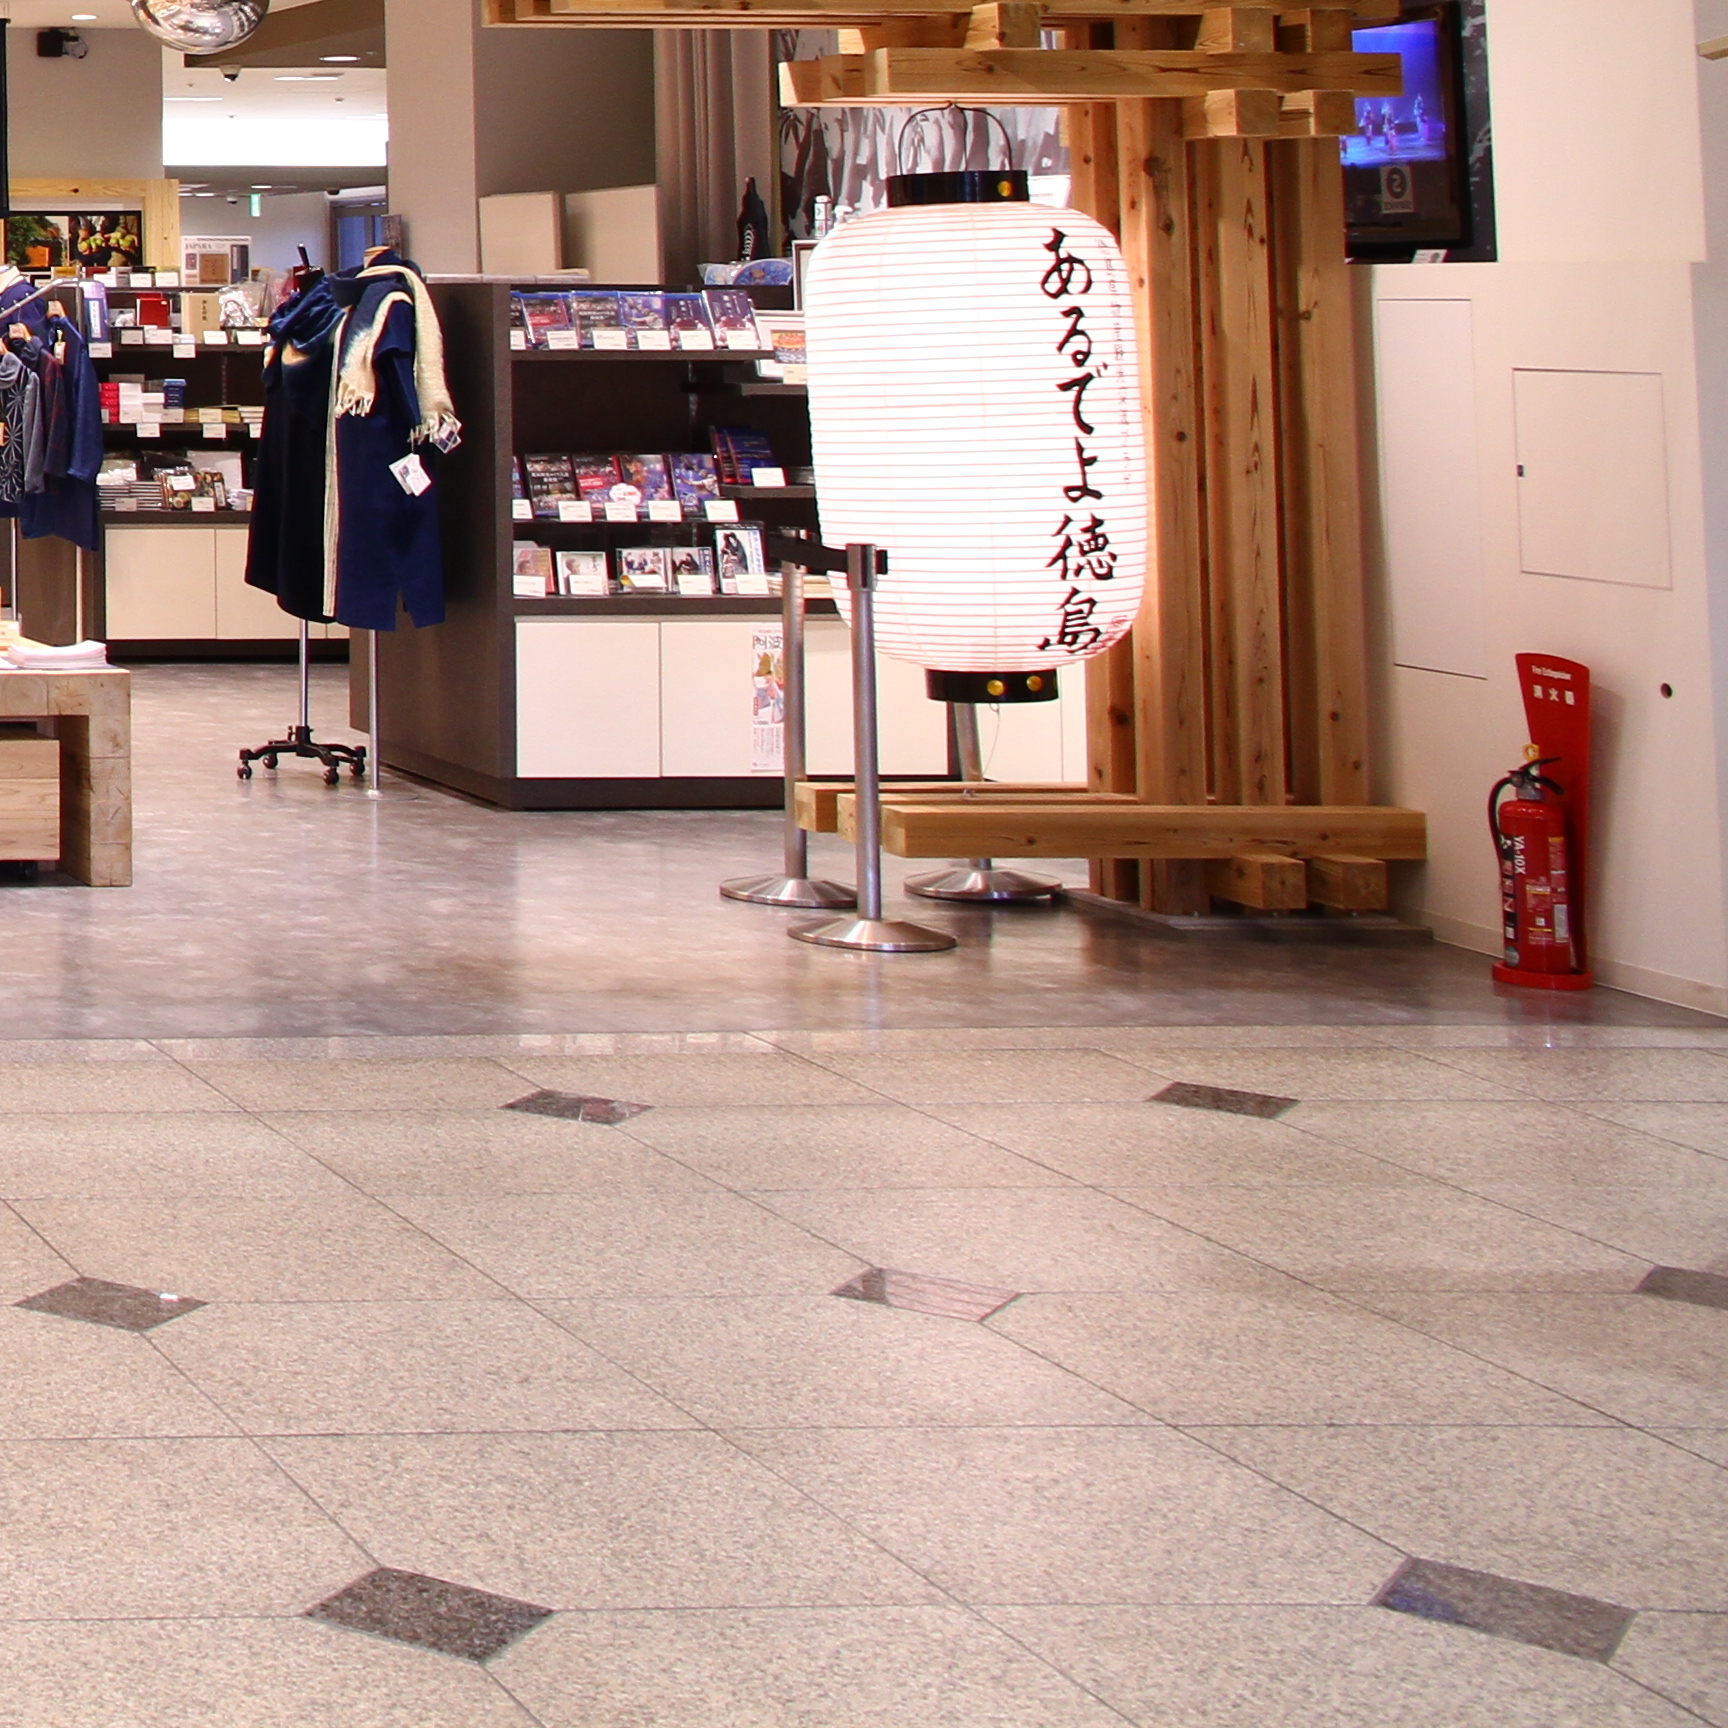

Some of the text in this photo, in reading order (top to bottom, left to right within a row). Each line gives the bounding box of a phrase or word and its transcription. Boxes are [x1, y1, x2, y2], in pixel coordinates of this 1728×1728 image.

[1038, 228, 1118, 654] あるでよ徳島
[1513, 836, 1527, 875] YA-10X
